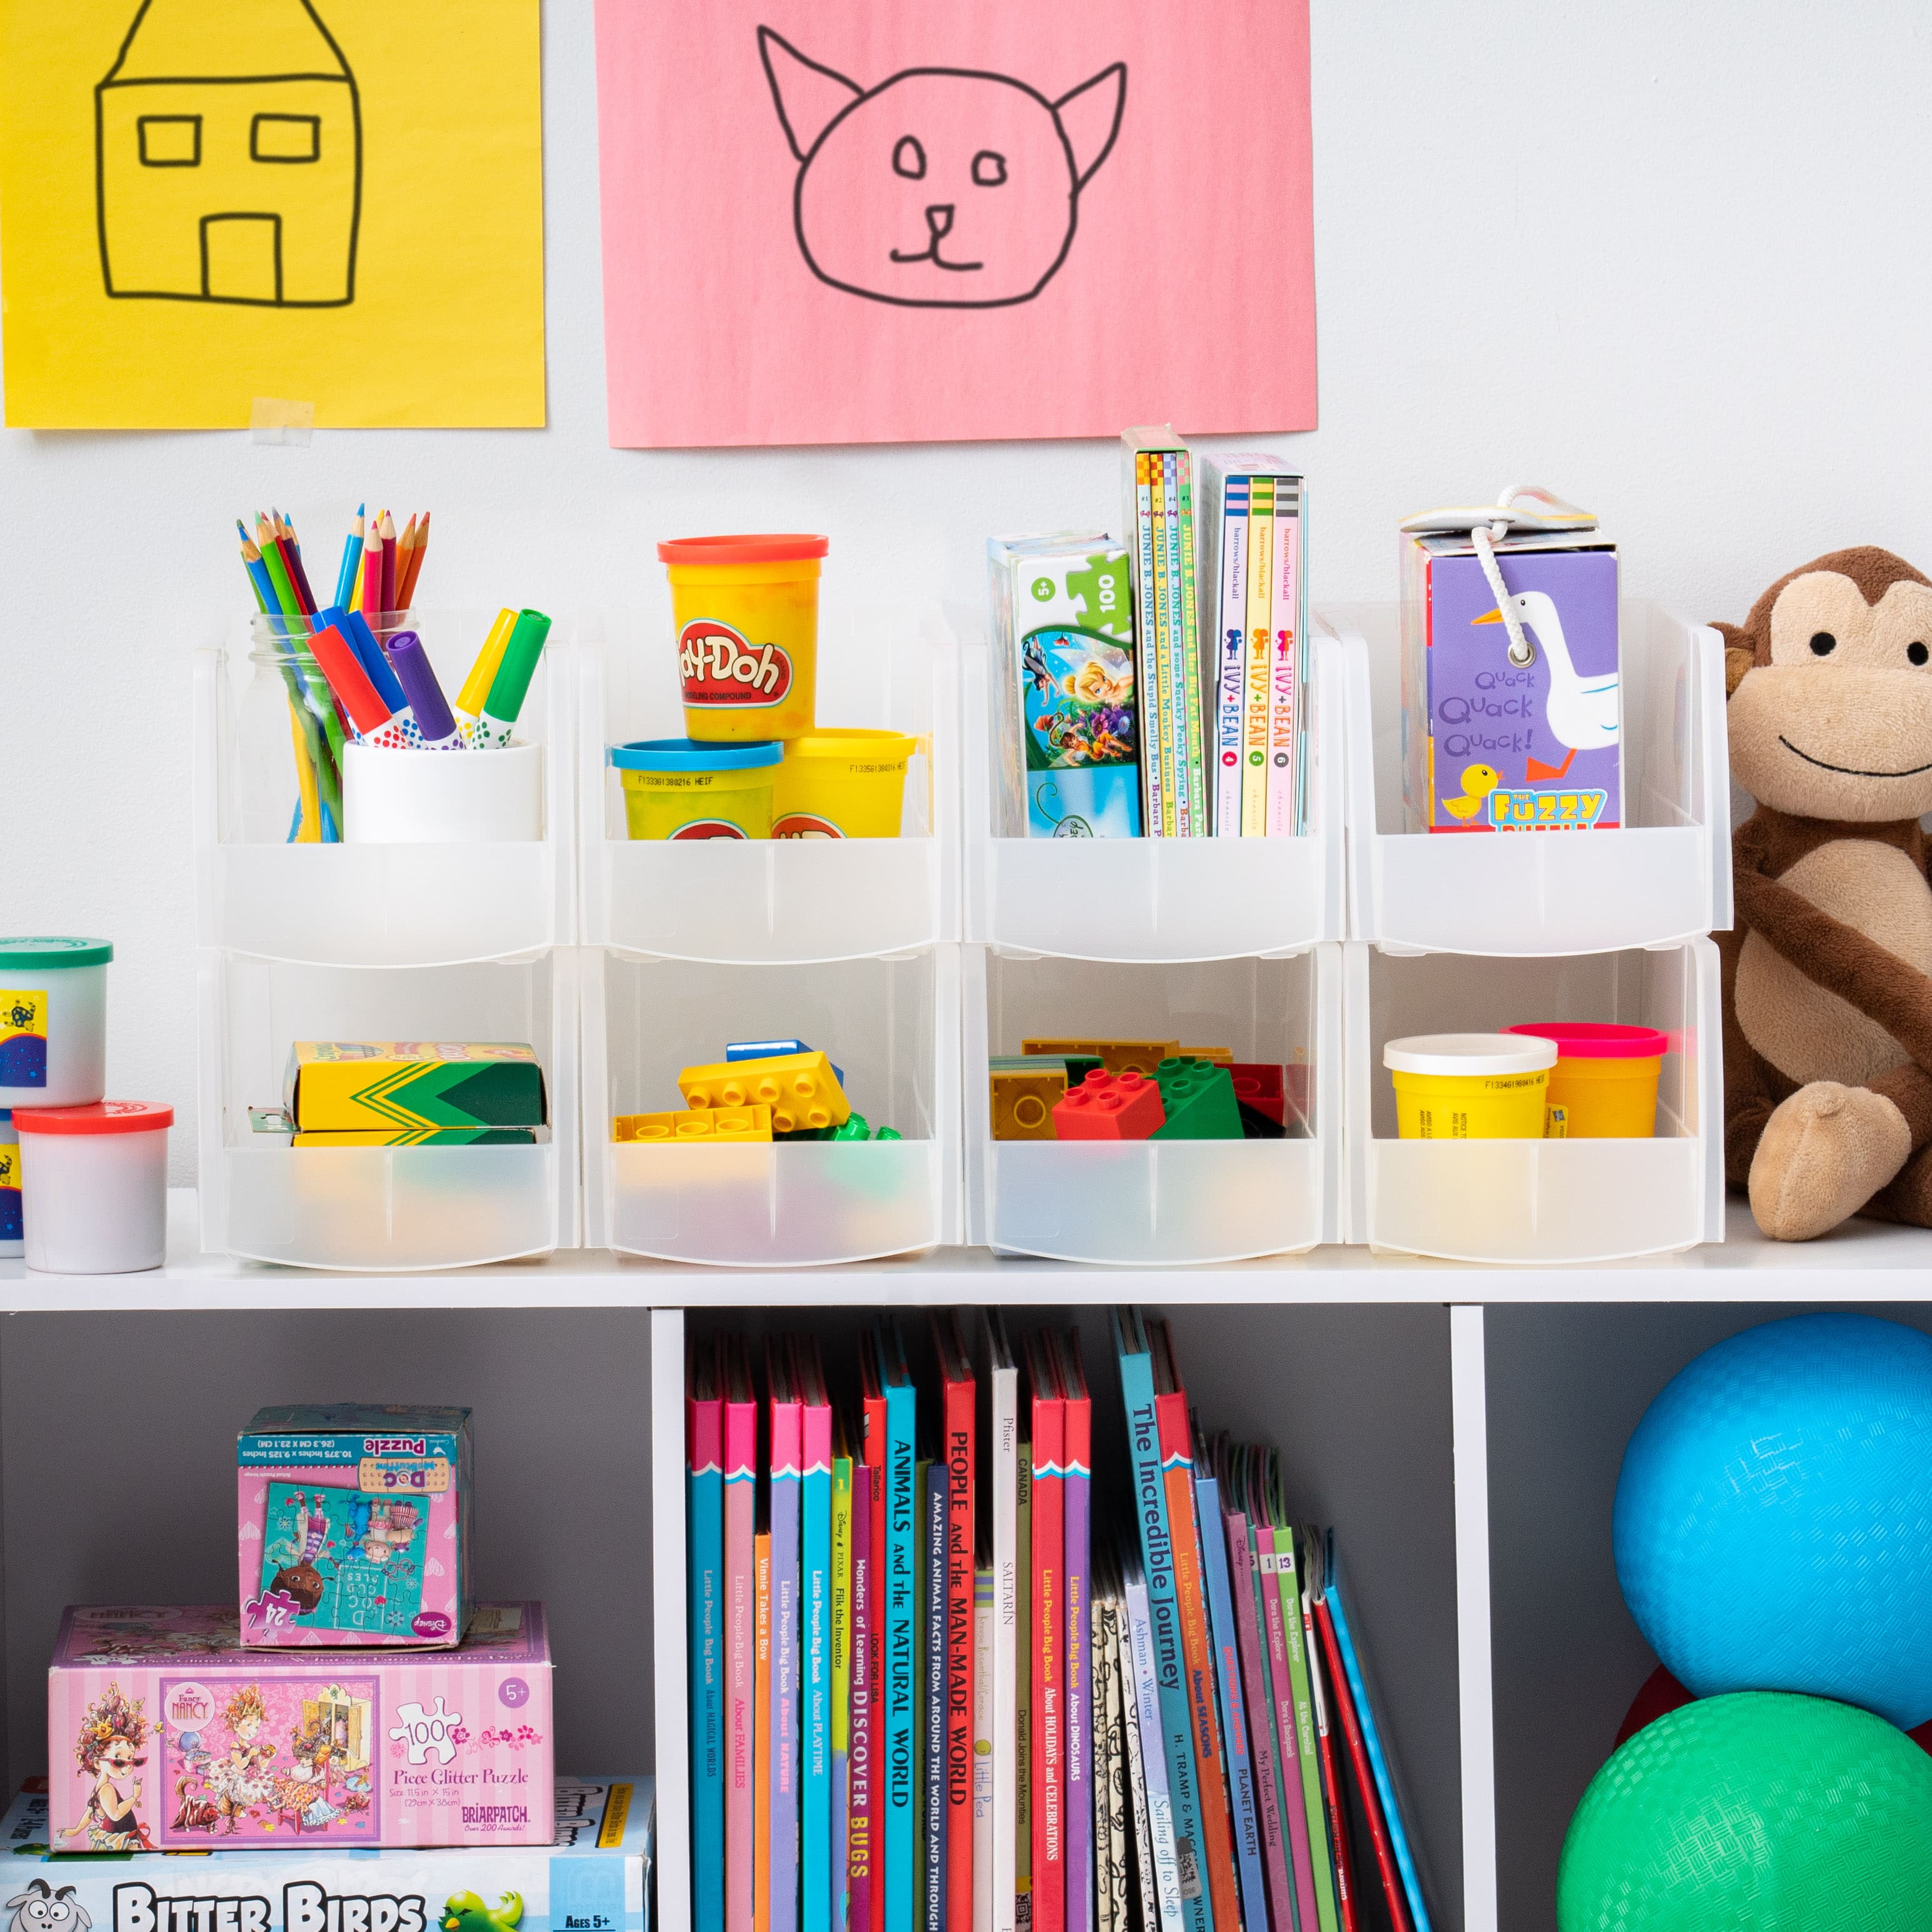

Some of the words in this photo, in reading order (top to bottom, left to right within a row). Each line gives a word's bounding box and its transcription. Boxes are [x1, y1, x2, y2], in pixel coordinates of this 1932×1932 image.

[1143, 525, 1151, 566] JUNIE
[1170, 525, 1179, 566] JUNIE
[1144, 569, 1151, 581] B.
[1171, 569, 1179, 581] B.
[1232, 528, 1241, 599] barrows/blackall
[1038, 581, 1050, 596] 5+
[1098, 574, 1115, 613] 100
[1144, 584, 1154, 626] JONES
[1171, 583, 1180, 626] JONES
[1146, 629, 1154, 649] and
[1146, 653, 1156, 670] the
[1147, 673, 1156, 709] Stupid
[1475, 671, 1534, 690] Quack
[1175, 681, 1183, 720] Sneaky
[1438, 694, 1533, 725] Quack
[1148, 713, 1158, 749] Smelly
[1221, 704, 1239, 746] BEAN
[1444, 729, 1533, 758] Quack!
[695, 776, 714, 785] HEIF
[1178, 760, 1186, 798] Spying
[1151, 784, 1160, 826] Barbara
[1003, 1418, 1014, 1453] Pfister
[1133, 1403, 1153, 1451] The
[258, 1439, 273, 1448] CM)
[274, 1439, 290, 1448] 23.1
[300, 1439, 311, 1448] CM
[314, 1439, 335, 1448] (26.3
[365, 1439, 425, 1455] Puzzle
[873, 1465, 881, 1501] Tallarico
[893, 1440, 911, 1532] ANIMALS
[951, 1432, 968, 1511] PEOPLE
[1018, 1459, 1028, 1505] CANADA
[933, 1492, 942, 1554] AMAZING
[1138, 1460, 1173, 1589] Incredible
[759, 1558, 768, 1591] Vinnie
[1266, 1558, 1272, 1568] 1
[1279, 1557, 1291, 1569] 13
[813, 1570, 822, 1598] Little
[836, 1588, 845, 1607] Flik
[856, 1559, 866, 1610] Wonders
[932, 1558, 942, 1611] ANIMAL
[1003, 1561, 1014, 1625] SALTARÍN
[1043, 1569, 1053, 1597] Little
[1070, 1576, 1079, 1604] Little
[266, 1603, 289, 1625] 24
[759, 1594, 768, 1624] Takes
[811, 1601, 821, 1635] People
[836, 1609, 845, 1624] the
[856, 1616, 866, 1628] of
[1042, 1599, 1052, 1634] People
[1069, 1606, 1079, 1641] People
[810, 1637, 821, 1654] Big
[834, 1627, 844, 1669] Inventor
[870, 1633, 878, 1659] LOOK
[931, 1615, 941, 1651] FACTS
[1042, 1636, 1053, 1653] Big
[1151, 1598, 1180, 1690] Journey
[759, 1639, 768, 1661] Bow
[854, 1634, 866, 1685] Learning
[949, 1598, 968, 1716] MAN-MADE
[1069, 1643, 1079, 1661] Big
[812, 1657, 821, 1683] Book
[870, 1661, 878, 1681] FOR
[892, 1619, 909, 1717] NATURAL
[931, 1656, 941, 1692] FROM
[1044, 1656, 1053, 1682] Book
[1070, 1662, 1079, 1689] Book
[1135, 1618, 1149, 1665] Ashman
[1142, 1678, 1154, 1720] Winter
[179, 1694, 200, 1703] Fancy
[505, 1684, 526, 1700] 5+
[813, 1690, 823, 1720] About
[870, 1683, 878, 1704] LISA
[1044, 1687, 1056, 1714] About
[173, 1702, 208, 1719] NANCY
[1070, 1693, 1080, 1723] About
[405, 1719, 444, 1746] 100
[931, 1696, 941, 1753] AROUND
[1018, 1709, 1028, 1740] Donald
[1045, 1716, 1057, 1764] HOLIDAYS
[813, 1723, 823, 1776] PLAYTIME
[853, 1691, 868, 1806] DISCOVER
[1018, 1742, 1027, 1766] Joins
[1070, 1726, 1080, 1781] DINOSAURS
[1301, 1726, 1313, 1755] Carnival
[892, 1728, 909, 1808] WORLD
[931, 1757, 940, 1781] THE
[949, 1726, 967, 1806] WORLD
[1258, 1751, 1268, 1765] My
[394, 1769, 428, 1785] Piece
[431, 1769, 479, 1785] Glitter
[483, 1768, 529, 1785] Puzzle
[975, 1761, 991, 1792] Little
[1018, 1768, 1027, 1782] the
[1046, 1767, 1056, 1782] and
[1261, 1768, 1271, 1803] Perfect
[404, 1798, 428, 1807] (29cm
[436, 1798, 460, 1807] 38cm)
[1017, 1784, 1027, 1825] Mounties
[1238, 1769, 1252, 1813] PLANET
[930, 1785, 940, 1831] WORLD
[974, 1796, 993, 1818] Pea
[1046, 1785, 1058, 1860] CELEBRATIONS
[1153, 1800, 1172, 1843] Sailing
[480, 1823, 497, 1831] 200
[1243, 1818, 1257, 1856] EARTH
[1266, 1806, 1278, 1846] Wedding
[850, 1816, 868, 1878] BUGS
[929, 1835, 939, 1863] AND
[1158, 1849, 1176, 1865] off
[1162, 1869, 1175, 1881] to
[113, 1881, 271, 1932] BITTER
[283, 1880, 426, 1932] BIRDS
[1163, 1886, 1180, 1917] Sleep
[594, 1915, 610, 1928] 5+
